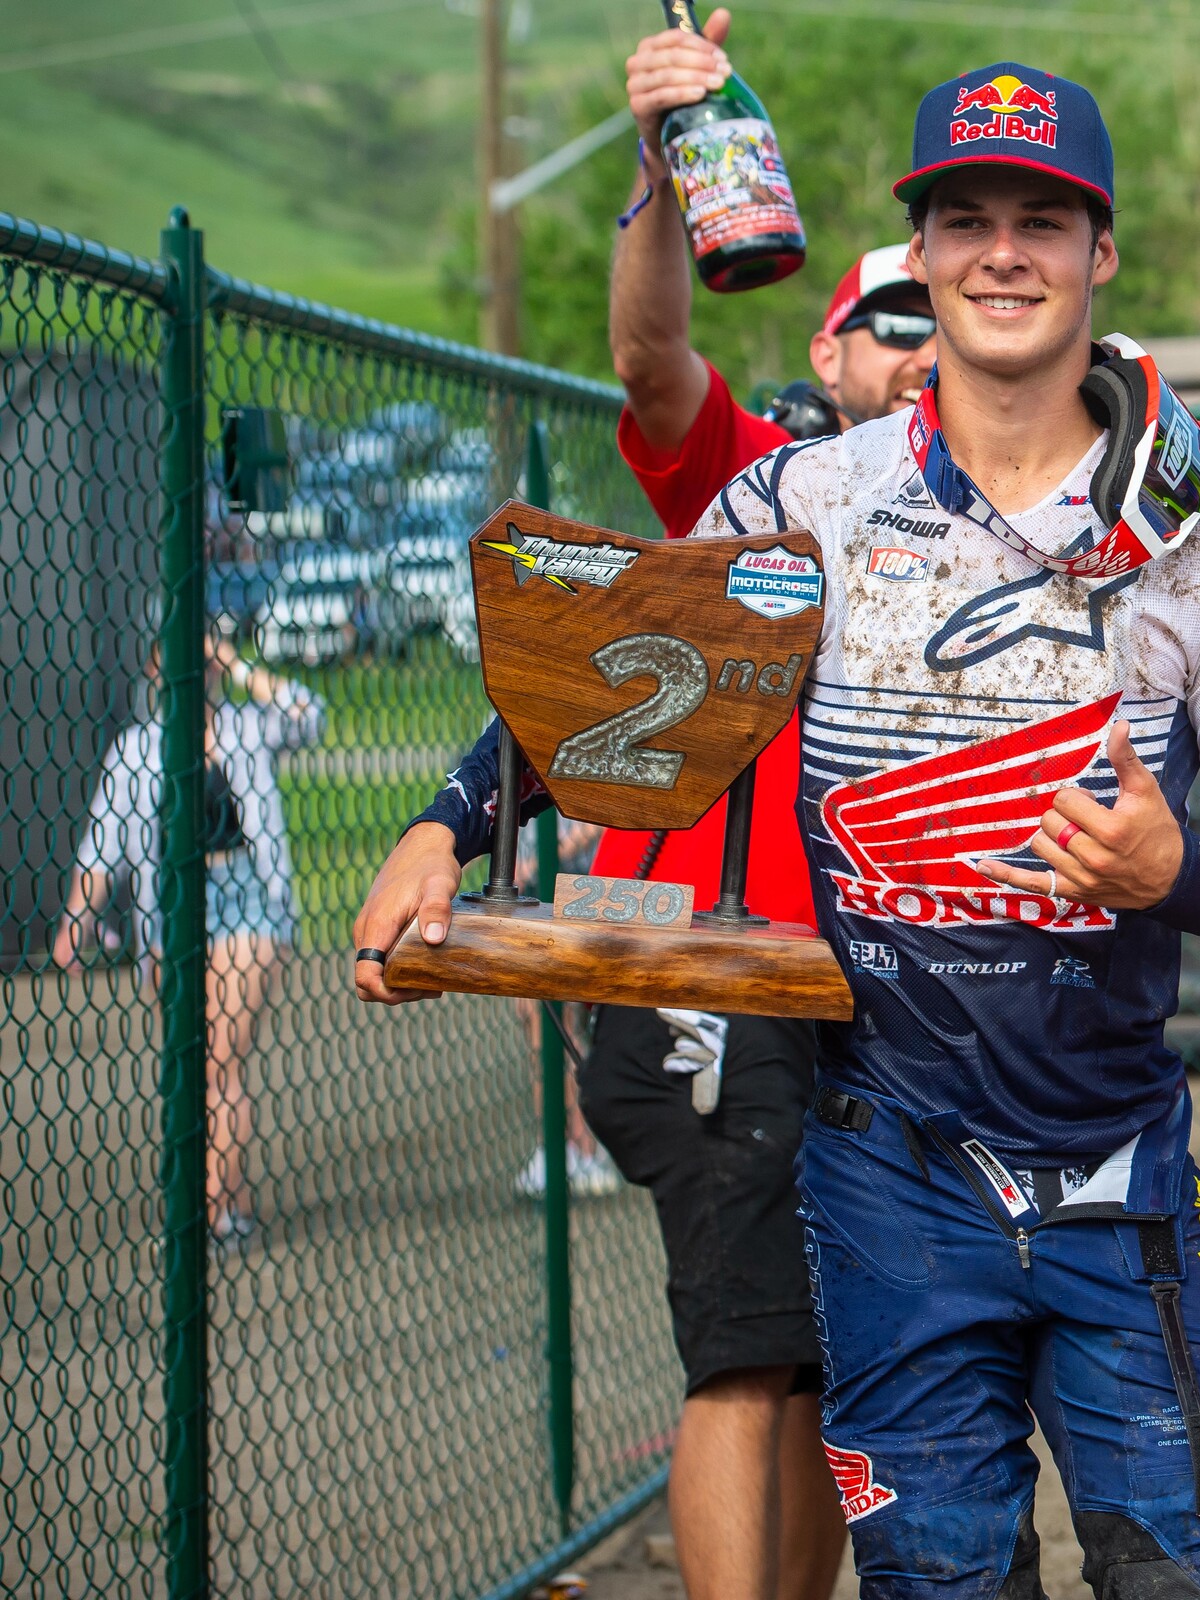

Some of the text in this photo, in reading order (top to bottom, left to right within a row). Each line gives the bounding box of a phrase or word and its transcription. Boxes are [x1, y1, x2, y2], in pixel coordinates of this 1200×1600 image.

[950, 113, 1057, 149] Red Bull
[911, 425, 924, 453] 18
[866, 509, 952, 540] SHOWA
[965, 489, 1131, 578] 100%
[517, 535, 641, 565] Thunder
[745, 557, 807, 573] LUCAS OIL
[873, 550, 927, 580] 100%
[532, 556, 627, 587] Valley
[731, 576, 818, 594] MOTOCROSS
[731, 586, 818, 597] CHAMPIONSHIP
[562, 876, 685, 926] 250
[831, 874, 1116, 931] HONDA
[927, 961, 1027, 974] DUNLOP
[1162, 1405, 1180, 1414] RACE
